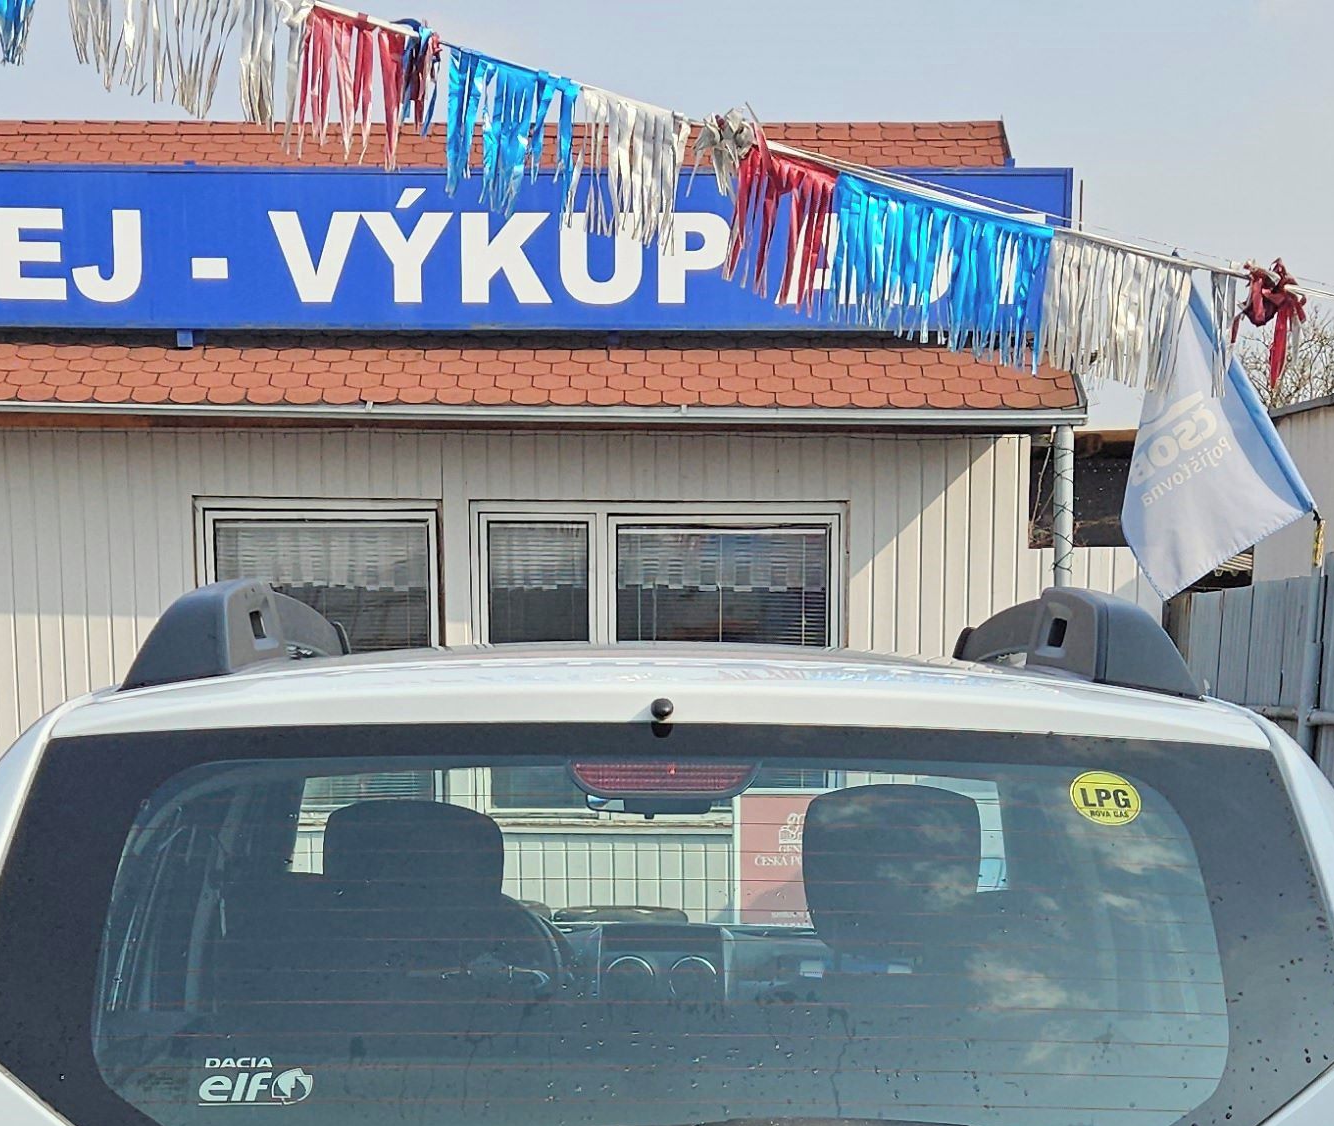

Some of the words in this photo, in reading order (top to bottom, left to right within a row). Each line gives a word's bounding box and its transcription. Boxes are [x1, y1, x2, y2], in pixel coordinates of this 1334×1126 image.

[267, 188, 731, 305] VÝKUP
[1079, 787, 1132, 809] LPG
[204, 1057, 273, 1068] DACIA
[198, 1072, 273, 1102] elf
